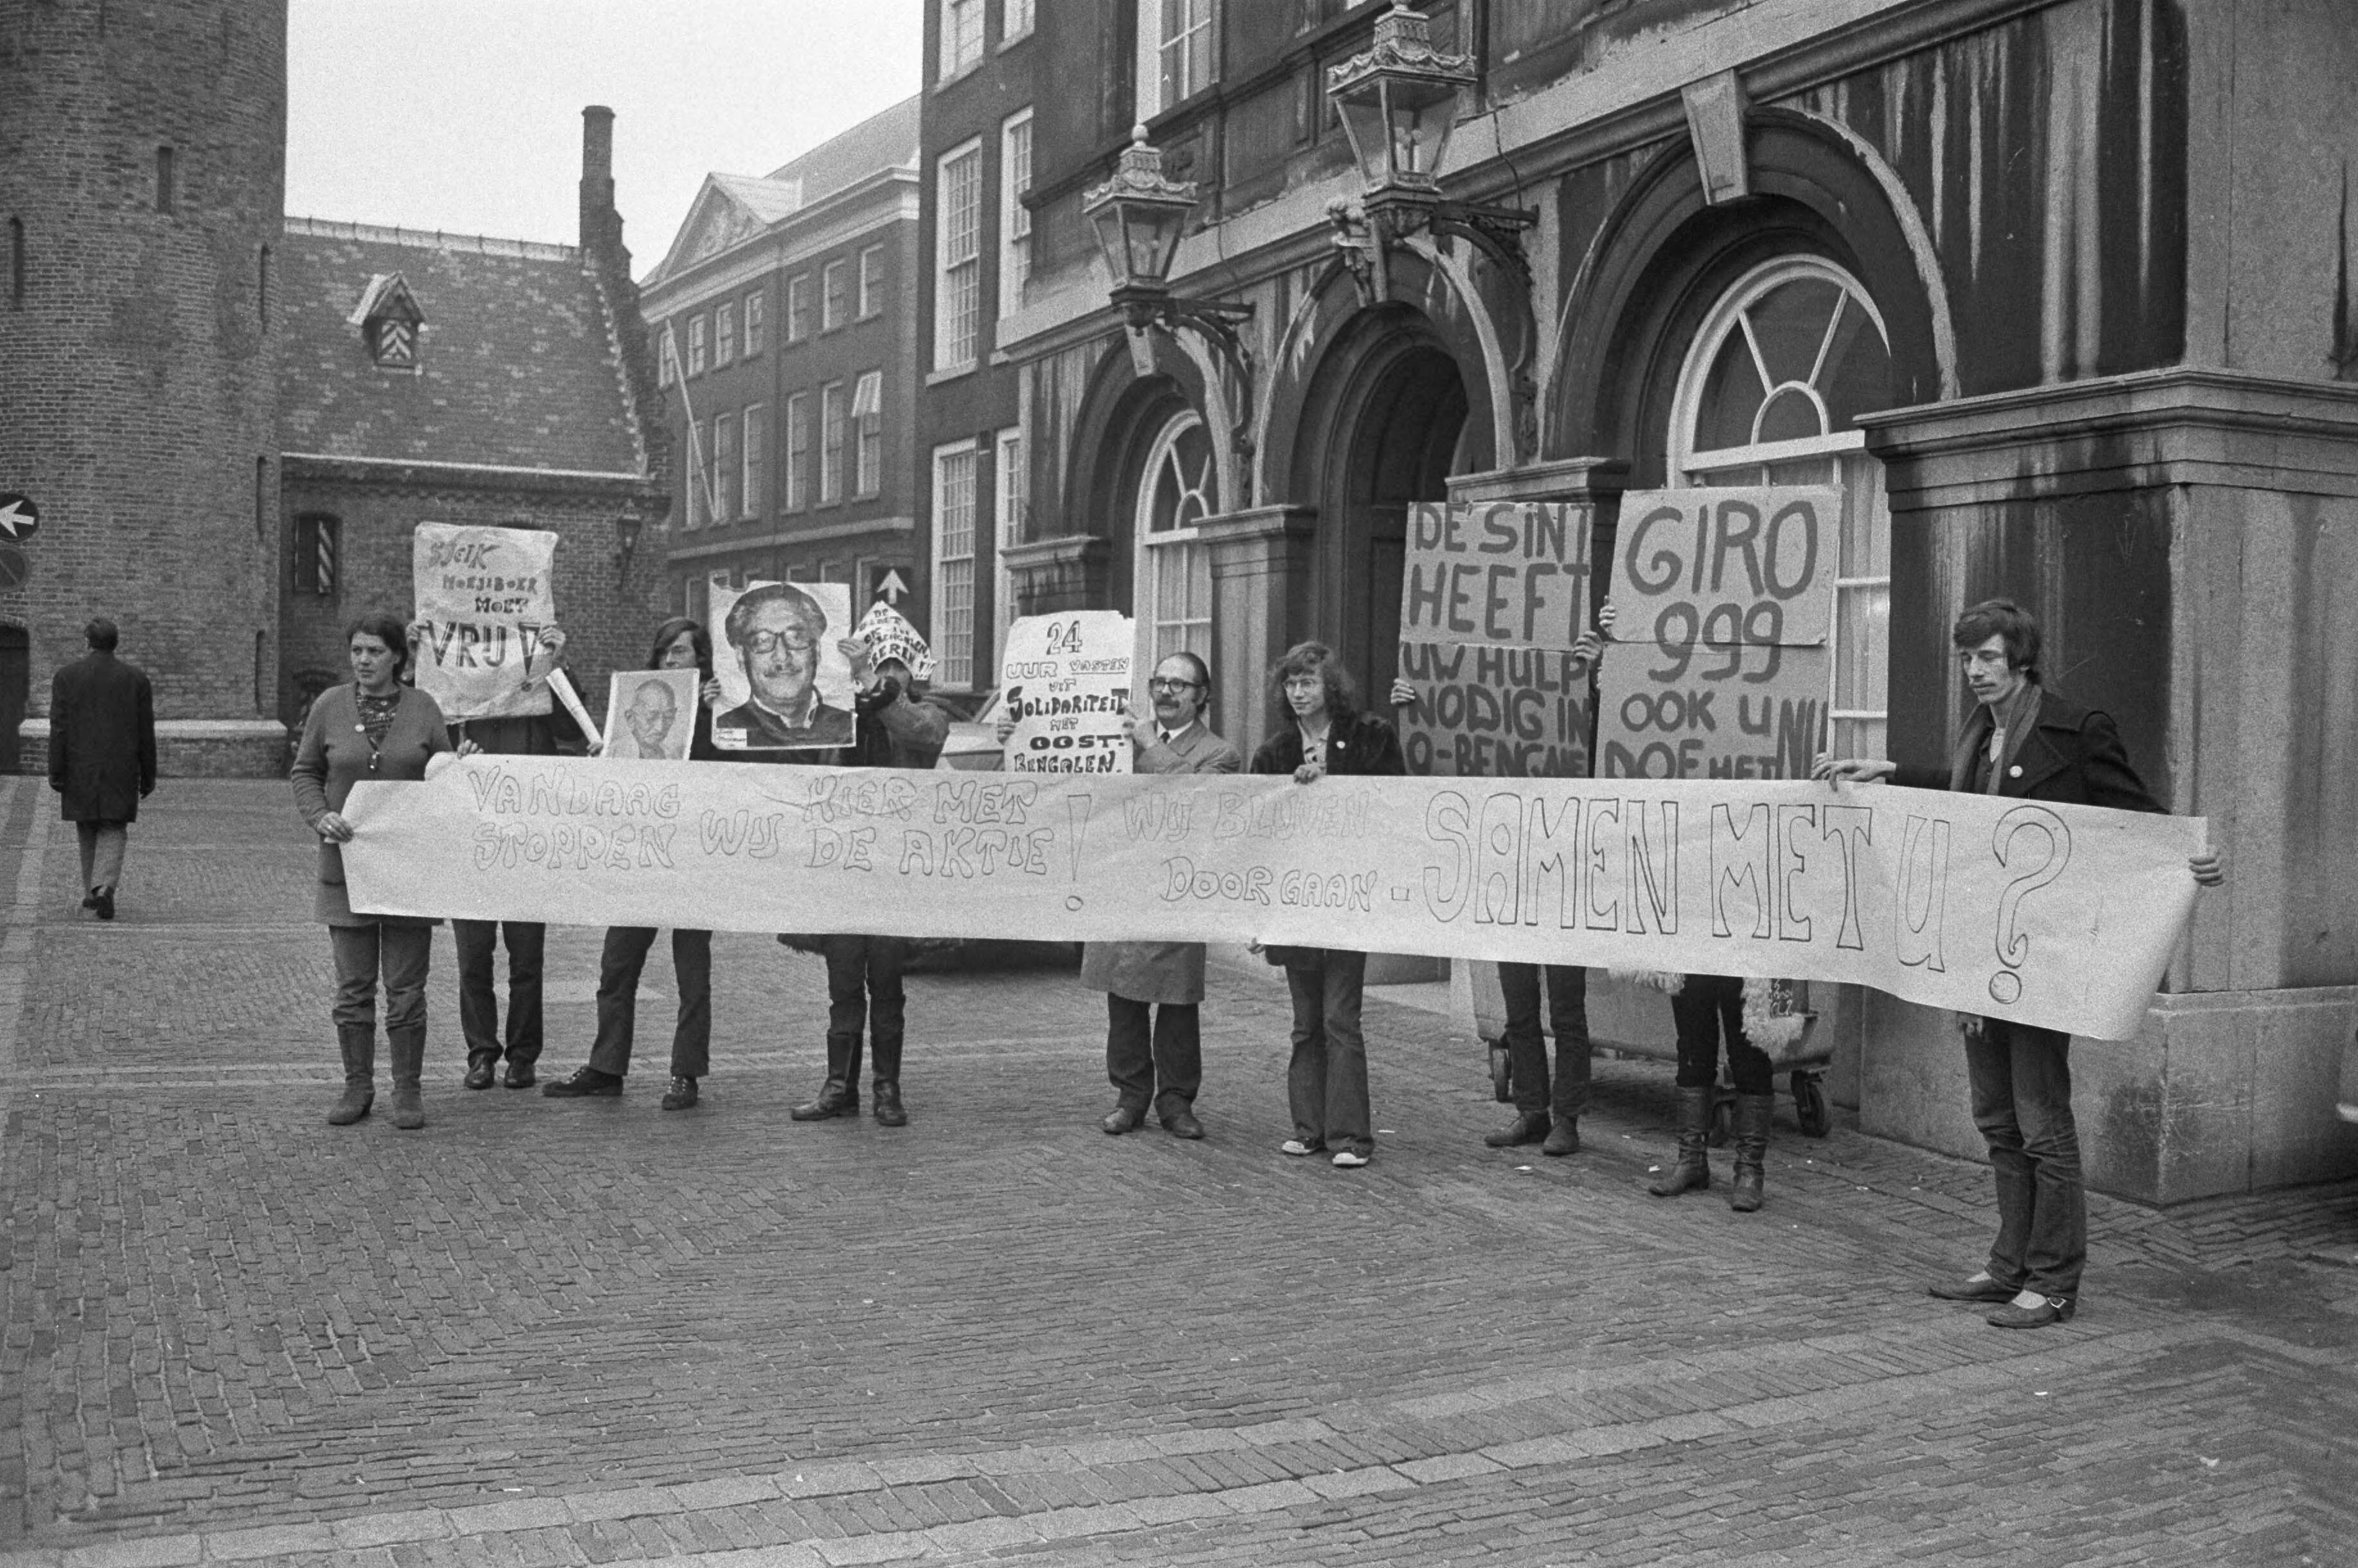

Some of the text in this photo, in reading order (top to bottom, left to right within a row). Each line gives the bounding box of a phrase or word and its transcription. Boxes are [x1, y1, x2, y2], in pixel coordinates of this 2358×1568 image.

[1414, 503, 1593, 564] DE SINT
[1626, 500, 1818, 600] GIRO
[475, 597, 529, 613] MOET
[1409, 561, 1590, 642] HEEFT
[1046, 620, 1083, 656] 24
[1647, 601, 1783, 683] 999
[1006, 661, 1058, 680] UUR
[1403, 642, 1585, 695] UW HULP
[1007, 685, 1129, 723] SOLIDARITEIT
[1409, 685, 1590, 747] NODIG IN
[1621, 690, 1772, 737] OOK U
[1605, 739, 1703, 779] DOE
[1709, 754, 1777, 779] HET
[467, 766, 681, 818] VANDAAG
[803, 776, 1037, 825] HIER MET
[473, 822, 676, 870] STOPPEN
[804, 827, 876, 871] DE
[900, 827, 1054, 878] AKTIE
[1422, 790, 2071, 1003] SAMEN MET U ?
